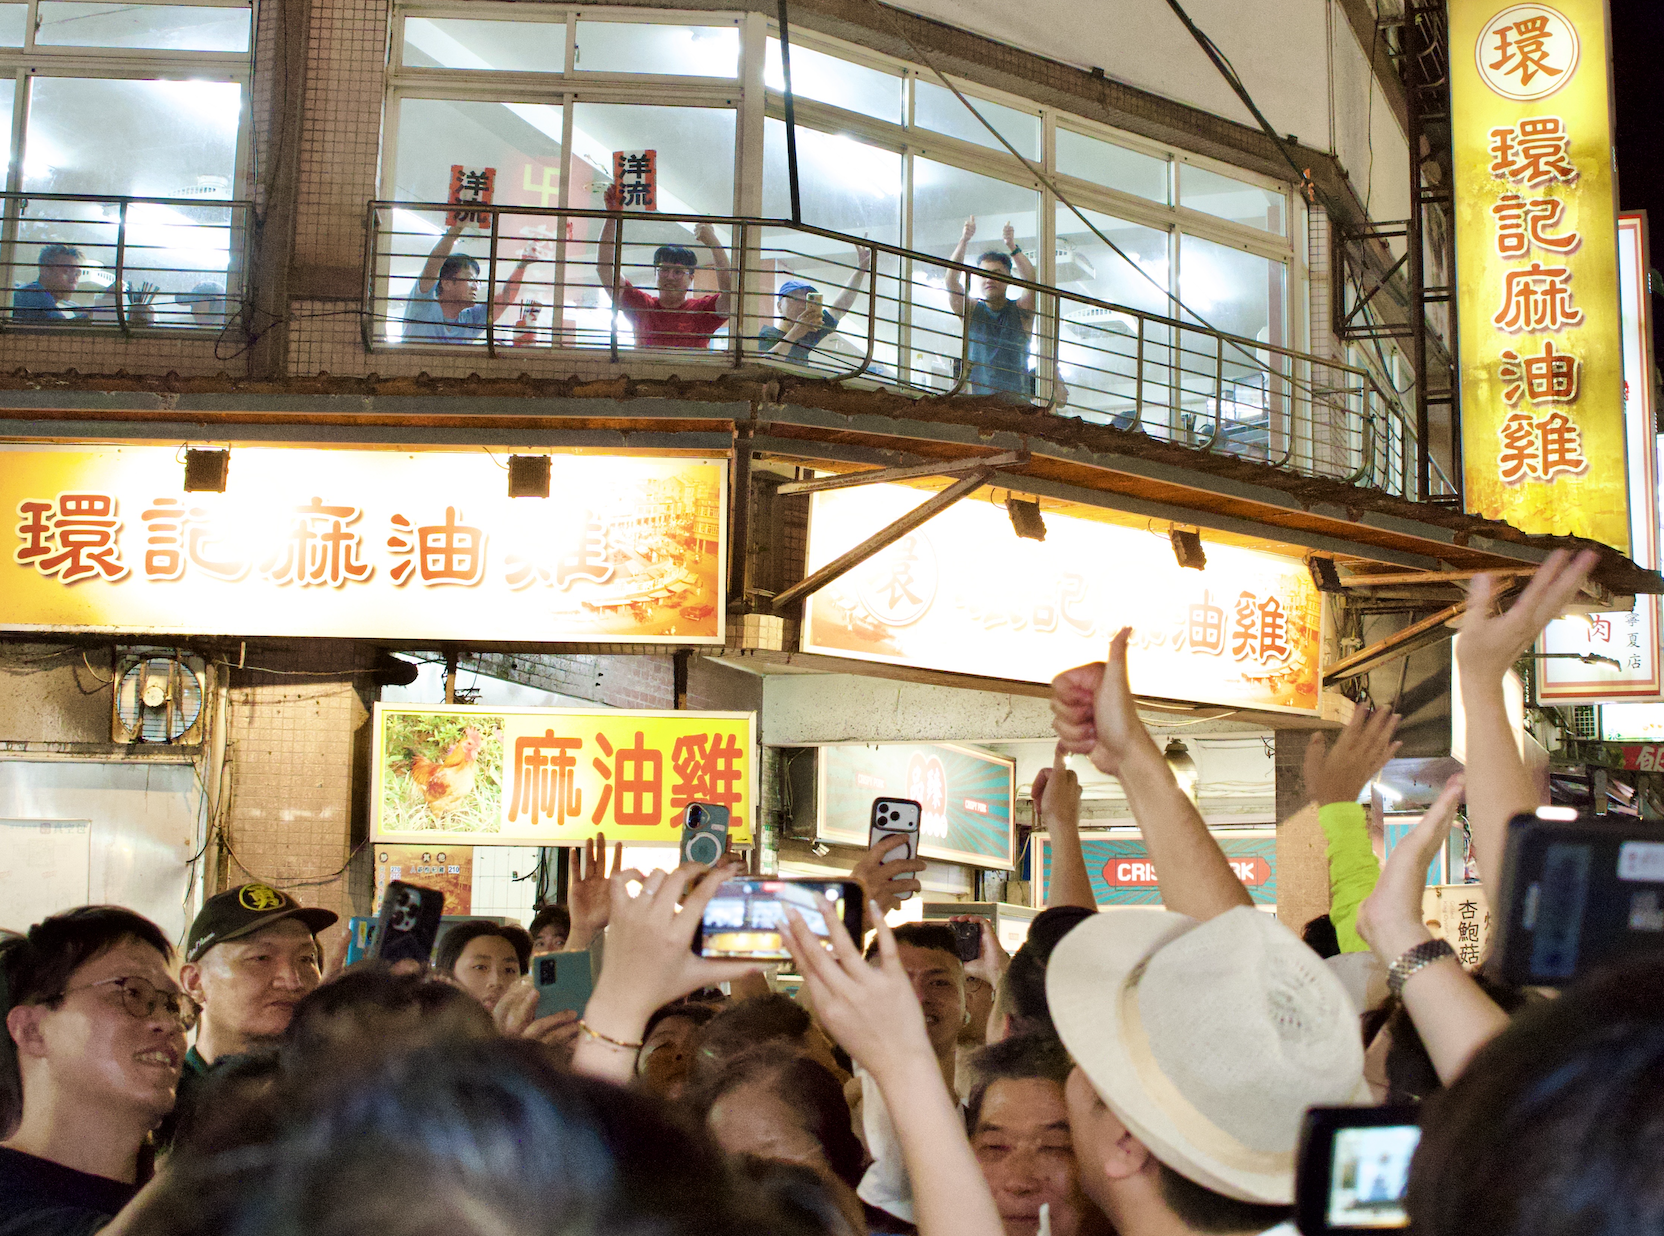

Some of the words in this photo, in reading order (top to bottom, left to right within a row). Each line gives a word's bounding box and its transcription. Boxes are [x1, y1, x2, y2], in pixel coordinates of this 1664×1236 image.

[1489, 15, 1563, 86] 環
[618, 153, 653, 207] 洋流
[1489, 117, 1586, 479] 環記麻油雞
[954, 571, 1289, 661] 記油雞
[1587, 614, 1611, 643] 肉
[508, 728, 744, 829] 麻油雞
[1117, 863, 1159, 881] CRIS
[1229, 862, 1255, 881] RK
[1458, 899, 1479, 965] 杏鮑菇
